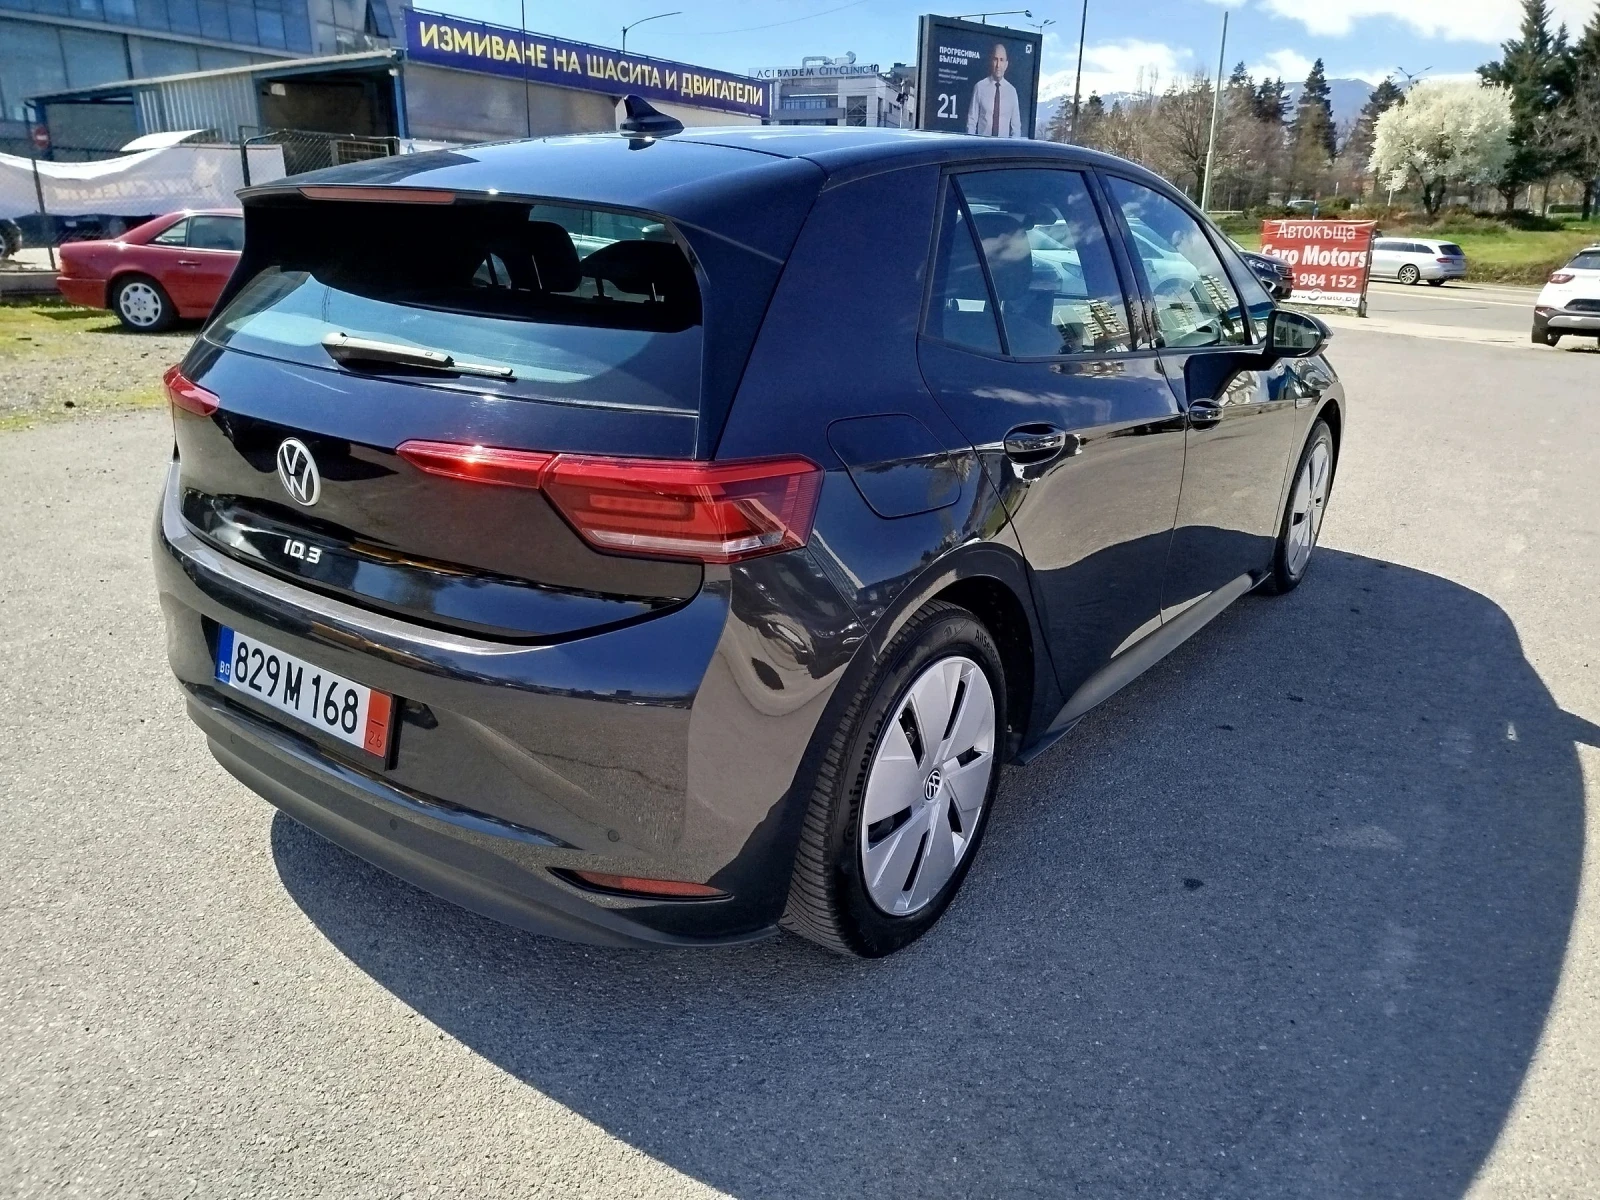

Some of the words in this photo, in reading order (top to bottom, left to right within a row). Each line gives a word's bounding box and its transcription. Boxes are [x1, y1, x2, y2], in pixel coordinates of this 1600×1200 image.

[939, 46, 980, 59] ПРОГРЕСИВНА
[939, 54, 968, 65] БЪЛГАРИЯ
[419, 21, 548, 69] ИЗМИВАНЕ
[553, 50, 582, 75] НА
[587, 54, 661, 89] ШАСИТА
[665, 70, 678, 91] И
[680, 72, 764, 107] ДВИГАТЕЛИ
[756, 67, 815, 78] ACIBADEM
[937, 93, 959, 119] 21
[1302, 245, 1368, 268] Motors
[1300, 273, 1327, 288] 984
[1330, 274, 1358, 289] 152
[219, 660, 231, 677] BG
[368, 729, 383, 749] 26
